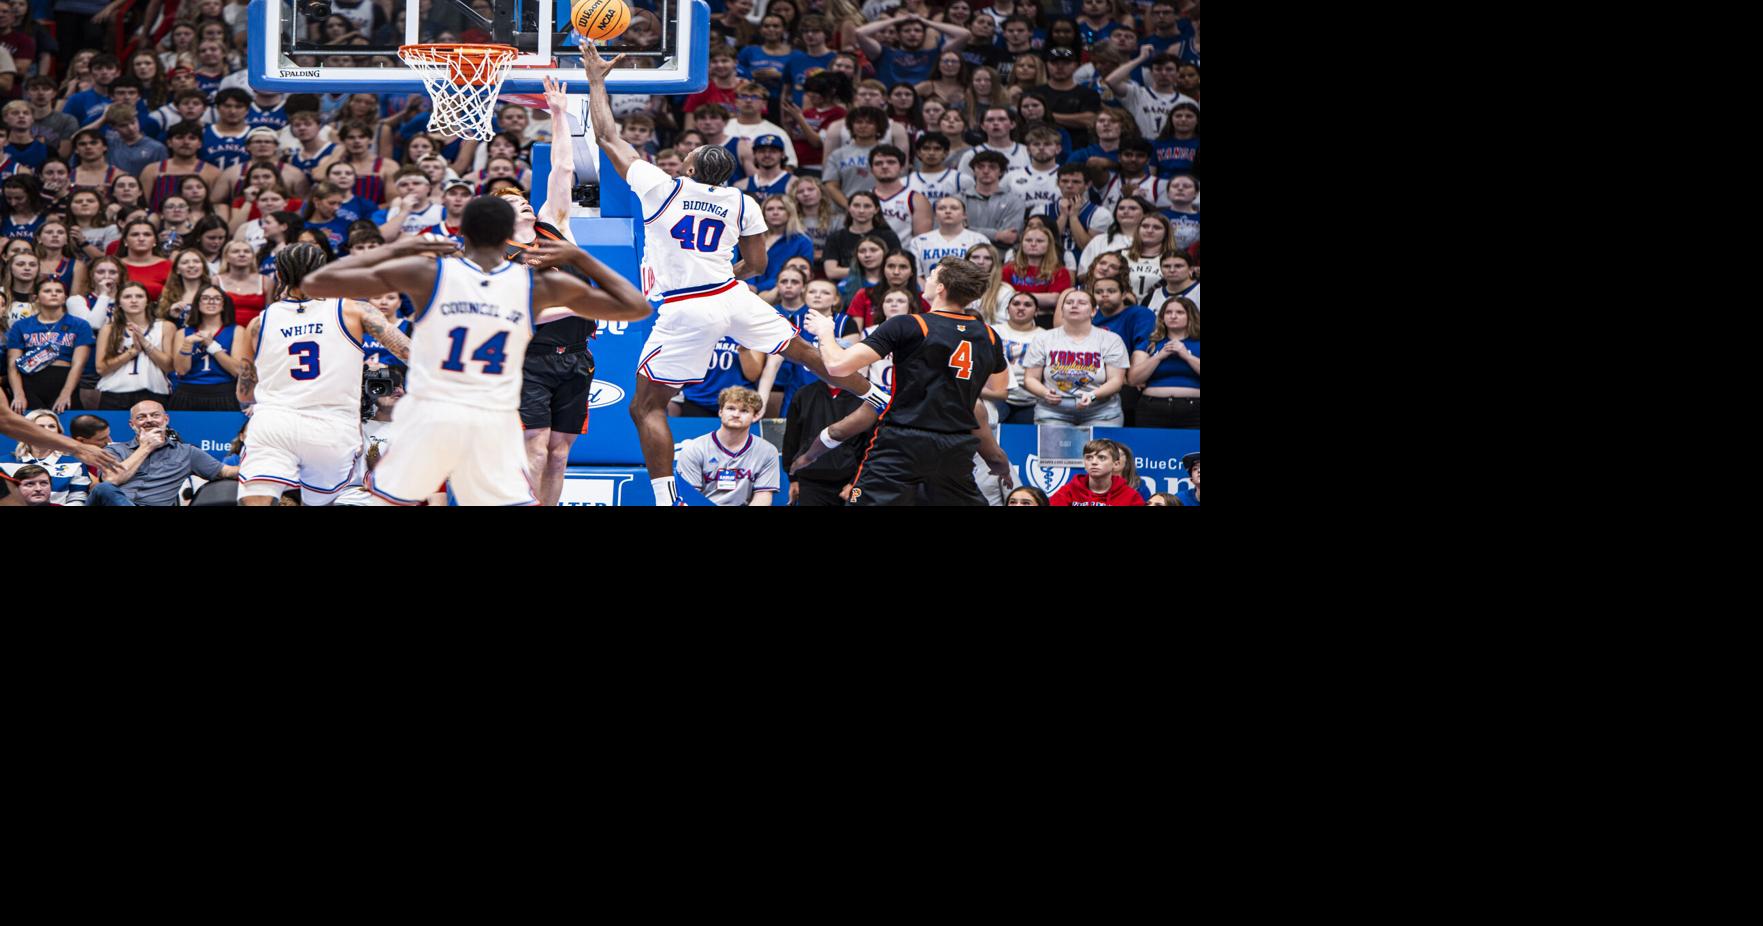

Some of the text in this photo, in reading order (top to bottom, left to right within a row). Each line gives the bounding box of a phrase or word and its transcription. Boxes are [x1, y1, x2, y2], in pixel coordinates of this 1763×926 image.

[597, 9, 616, 31] NCAA
[279, 70, 320, 78] SPALDING
[208, 143, 249, 154] KANSA
[1025, 190, 1056, 202] ANSA
[682, 200, 728, 218] BIDUNGA
[670, 214, 726, 252] 40
[923, 248, 967, 260] KANSA
[440, 301, 500, 318] COUNCIL
[280, 323, 323, 338] WHITE
[440, 326, 511, 375] 14
[201, 355, 211, 372] 1
[288, 340, 321, 381] 3
[948, 340, 973, 380] 4
